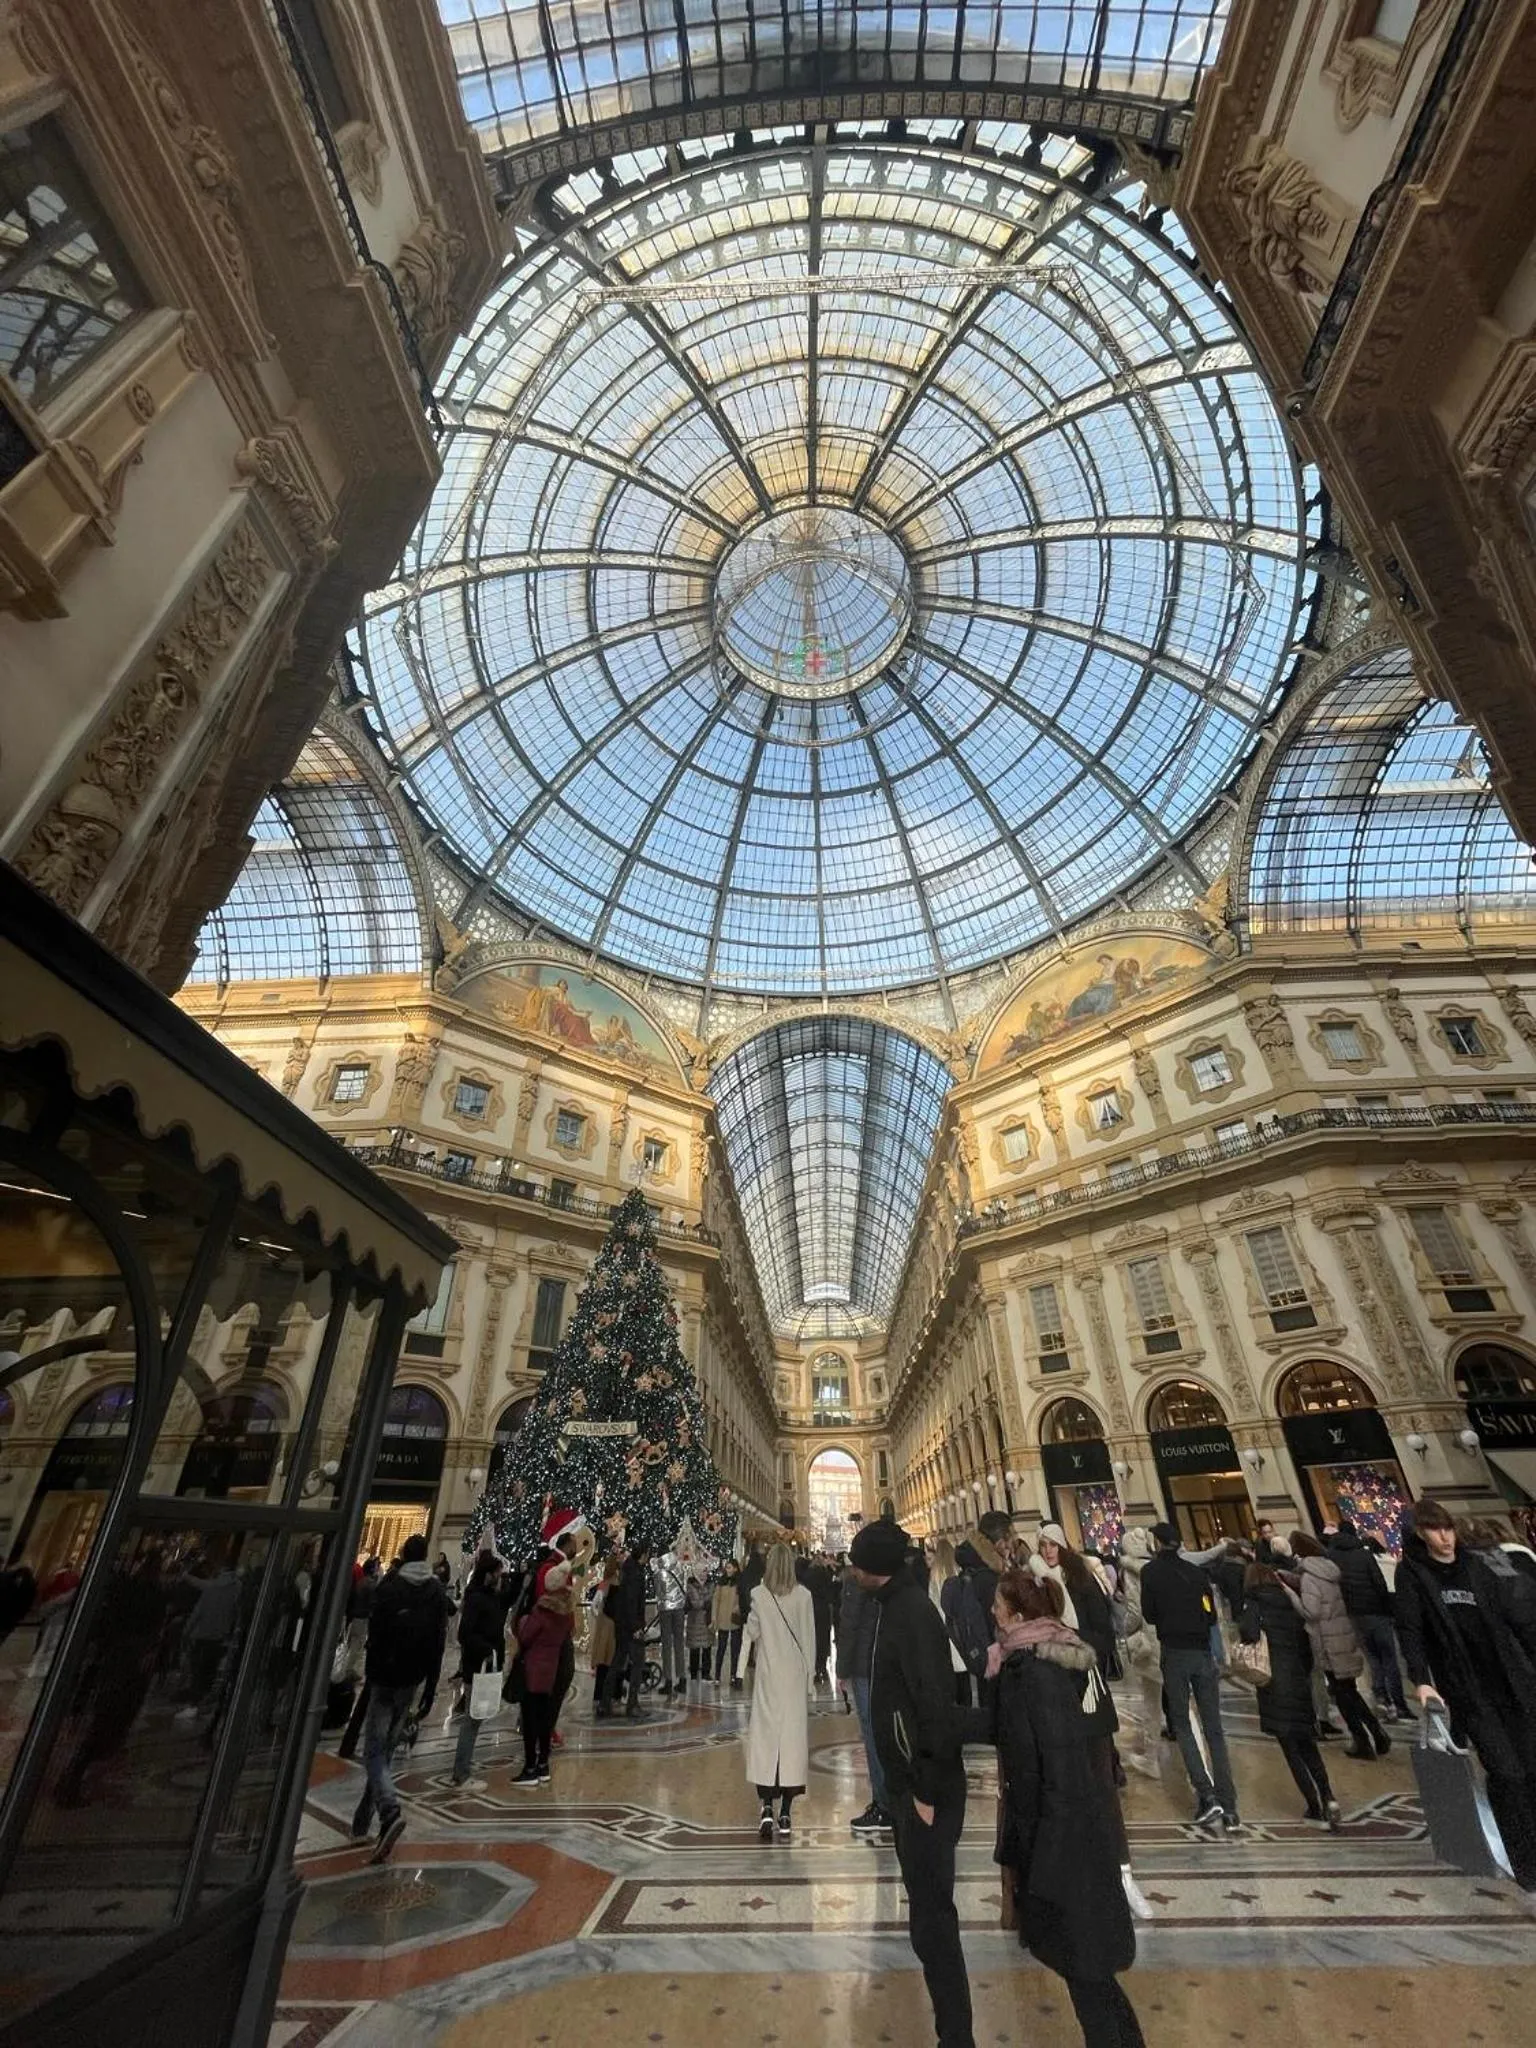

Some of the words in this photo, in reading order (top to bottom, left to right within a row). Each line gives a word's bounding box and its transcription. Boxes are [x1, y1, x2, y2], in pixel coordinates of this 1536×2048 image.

[1161, 1446, 1188, 1457] LOUIS
[1188, 1442, 1230, 1455] VUITTON
[377, 1452, 420, 1465] PRADA
